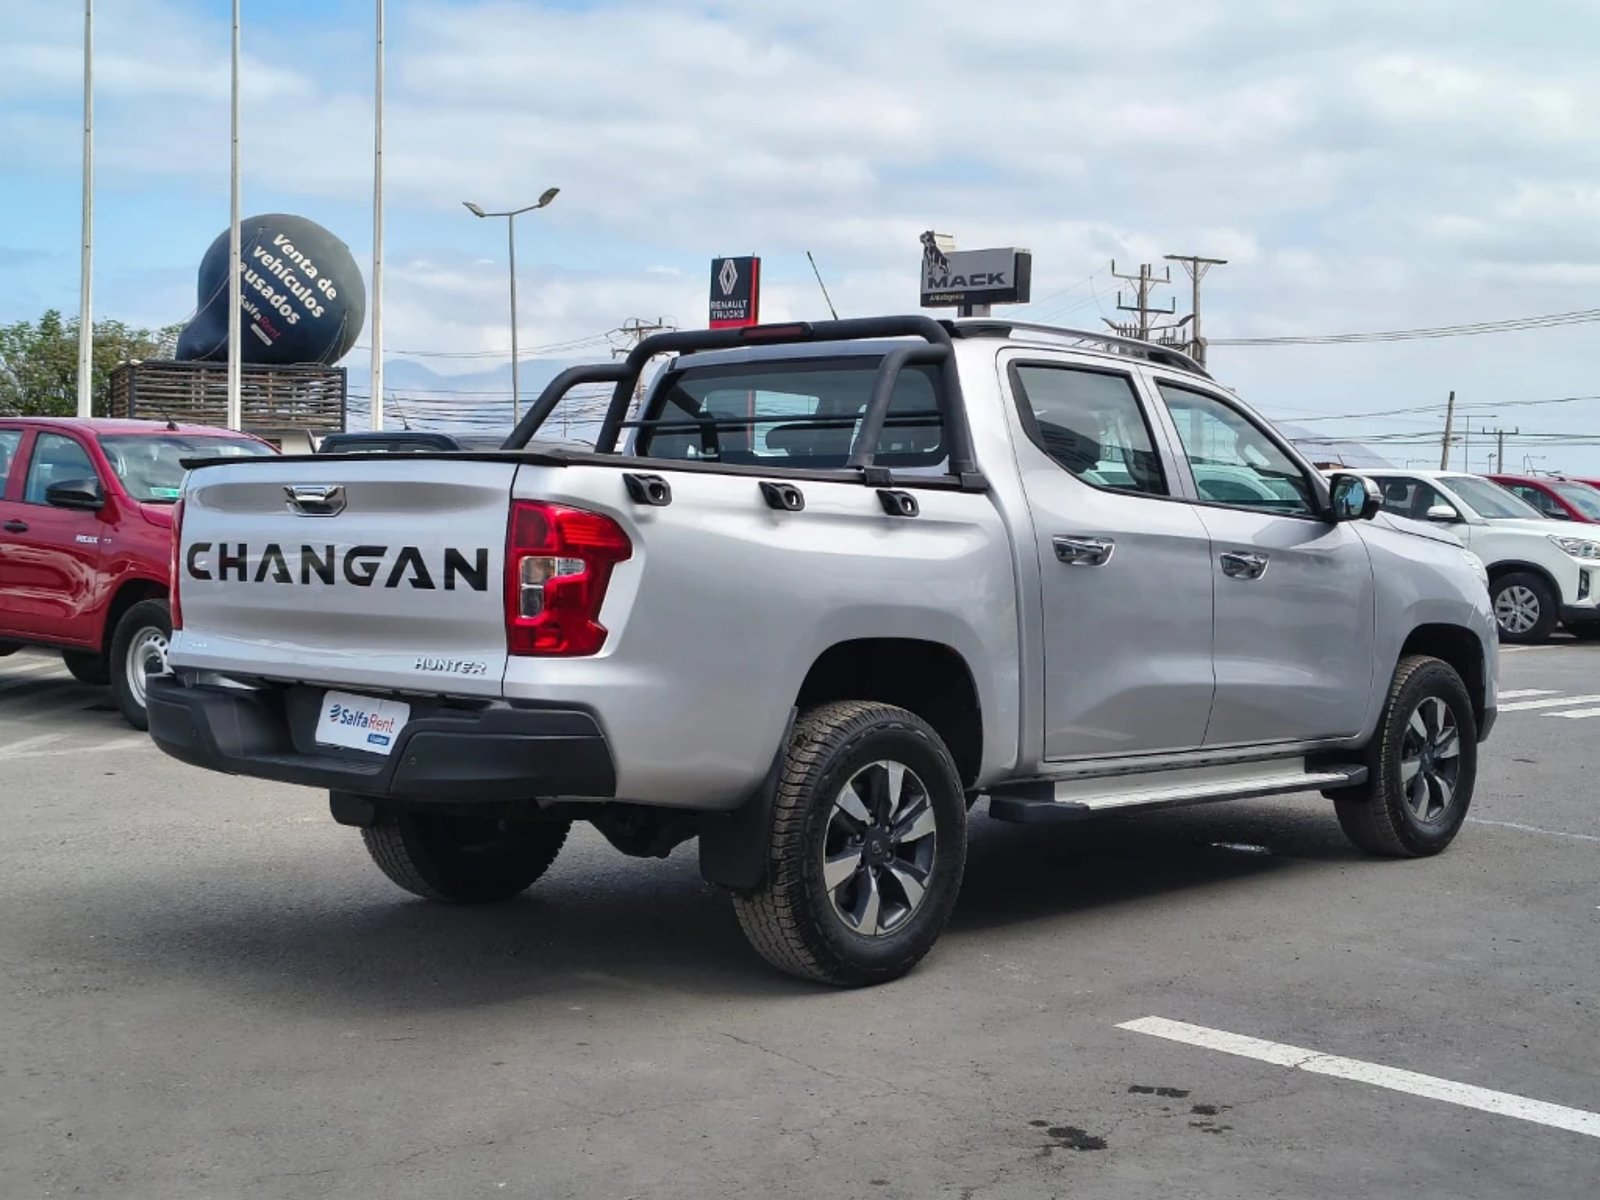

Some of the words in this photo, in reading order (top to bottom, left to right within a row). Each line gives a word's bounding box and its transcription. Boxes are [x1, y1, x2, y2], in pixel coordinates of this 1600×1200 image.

[272, 233, 318, 279] Venta
[317, 278, 337, 301] de
[253, 245, 325, 319] vehículos
[927, 271, 1006, 290] MACK
[244, 268, 301, 325] usados
[710, 299, 748, 310] RENAULT
[712, 309, 745, 320] TRUCKS
[186, 542, 489, 592] CHANGAN
[413, 656, 487, 675] HUNTER
[339, 708, 396, 734] SalfaRent
